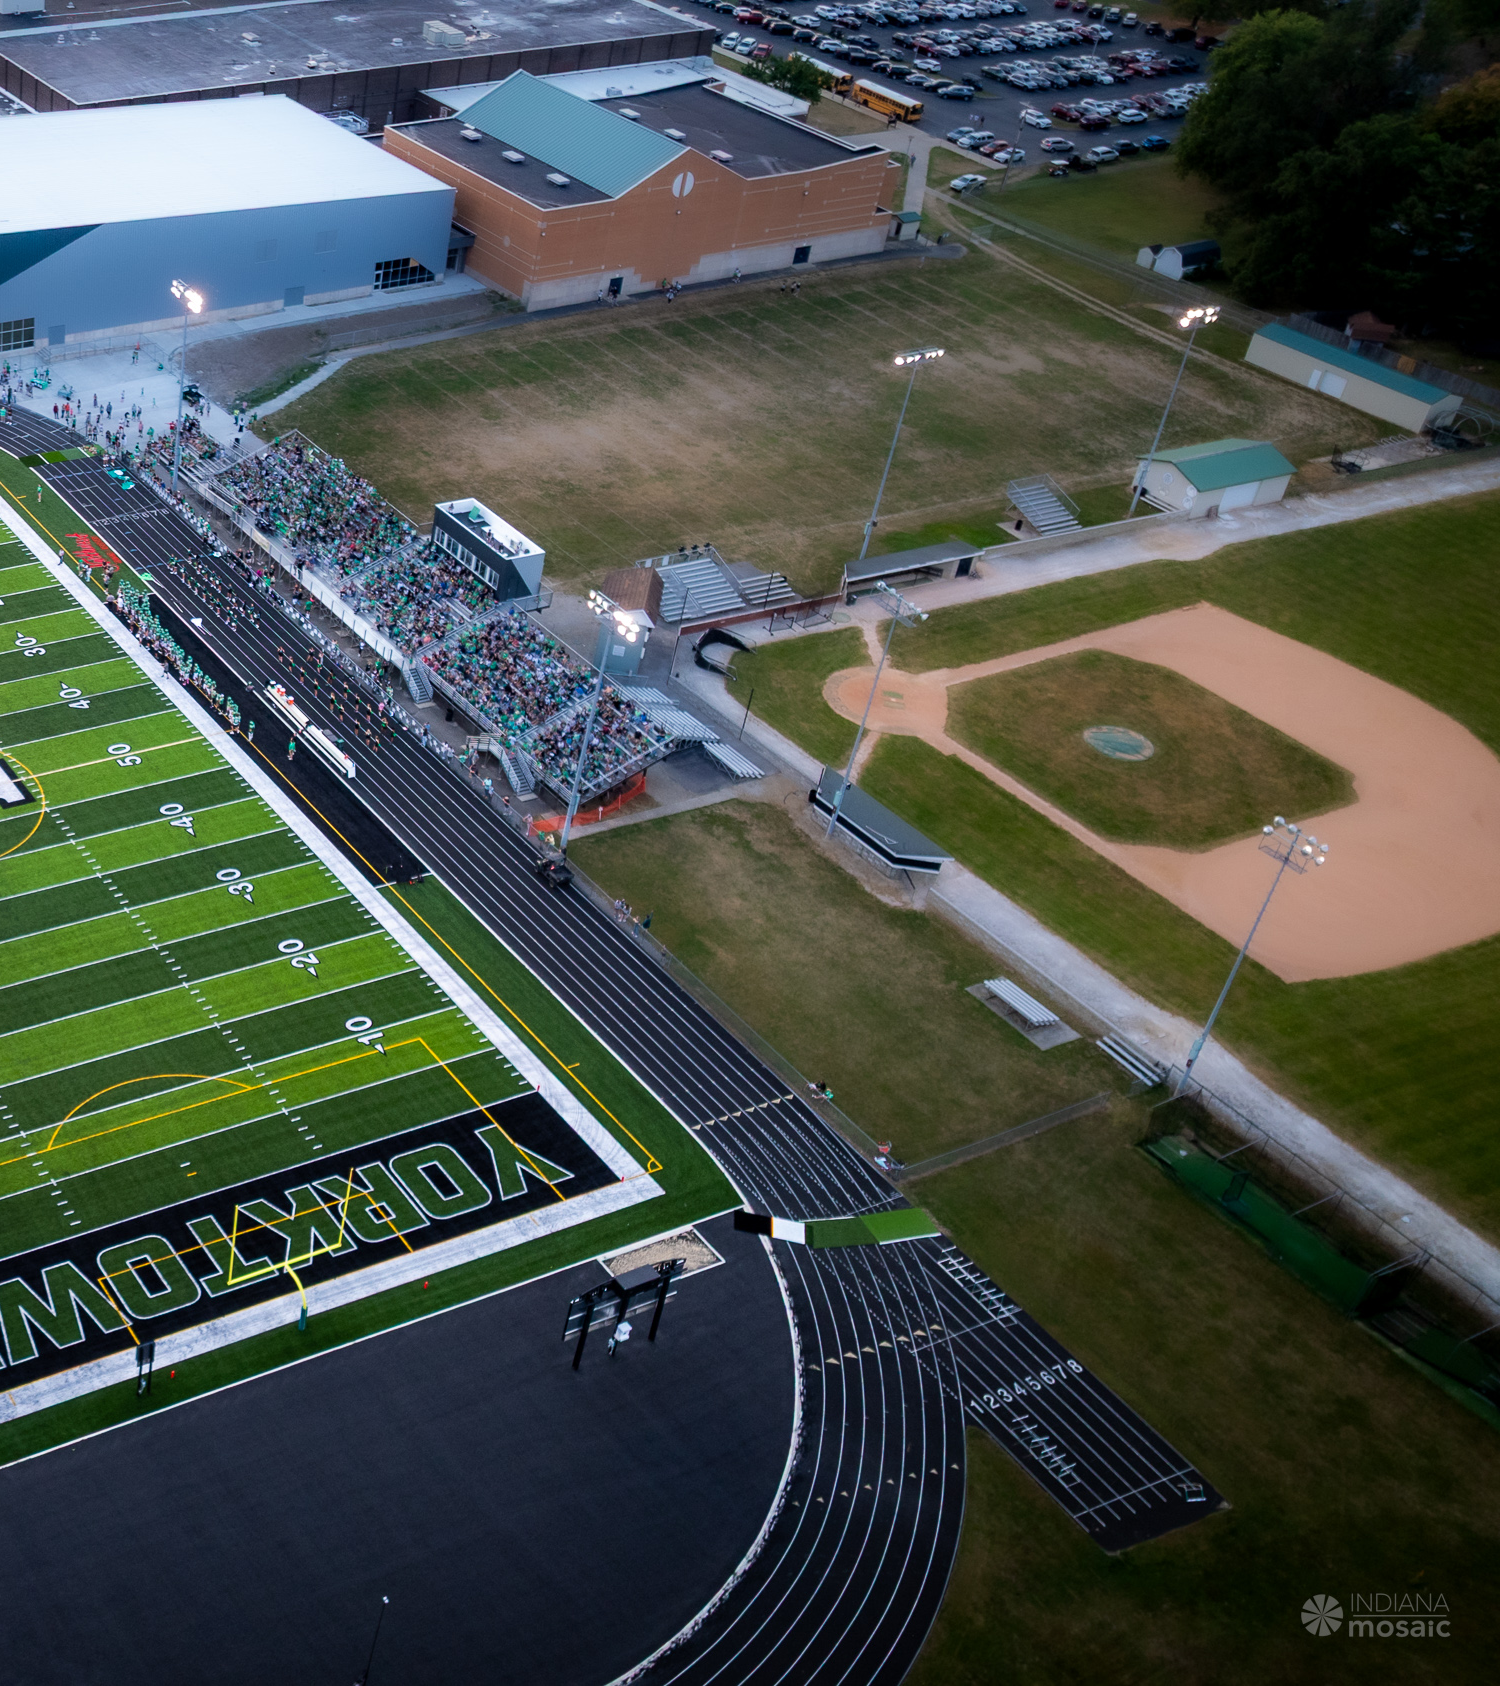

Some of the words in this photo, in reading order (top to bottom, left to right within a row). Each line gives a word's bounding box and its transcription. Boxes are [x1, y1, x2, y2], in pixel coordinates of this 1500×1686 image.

[14, 637, 47, 657] 30
[59, 688, 91, 709] 40
[107, 743, 142, 767] 50
[159, 803, 194, 828] 40
[215, 868, 254, 896] 30
[277, 939, 321, 968] 20
[345, 1016, 384, 1046] 10
[970, 1400, 984, 1414] 1
[983, 1394, 1000, 1409] 2
[997, 1388, 1013, 1403] 3
[1013, 1382, 1027, 1396] 4
[1025, 1376, 1041, 1391] 5
[1040, 1371, 1055, 1385] 6
[1052, 1364, 1067, 1379] 7
[1067, 1359, 1083, 1373] 8
